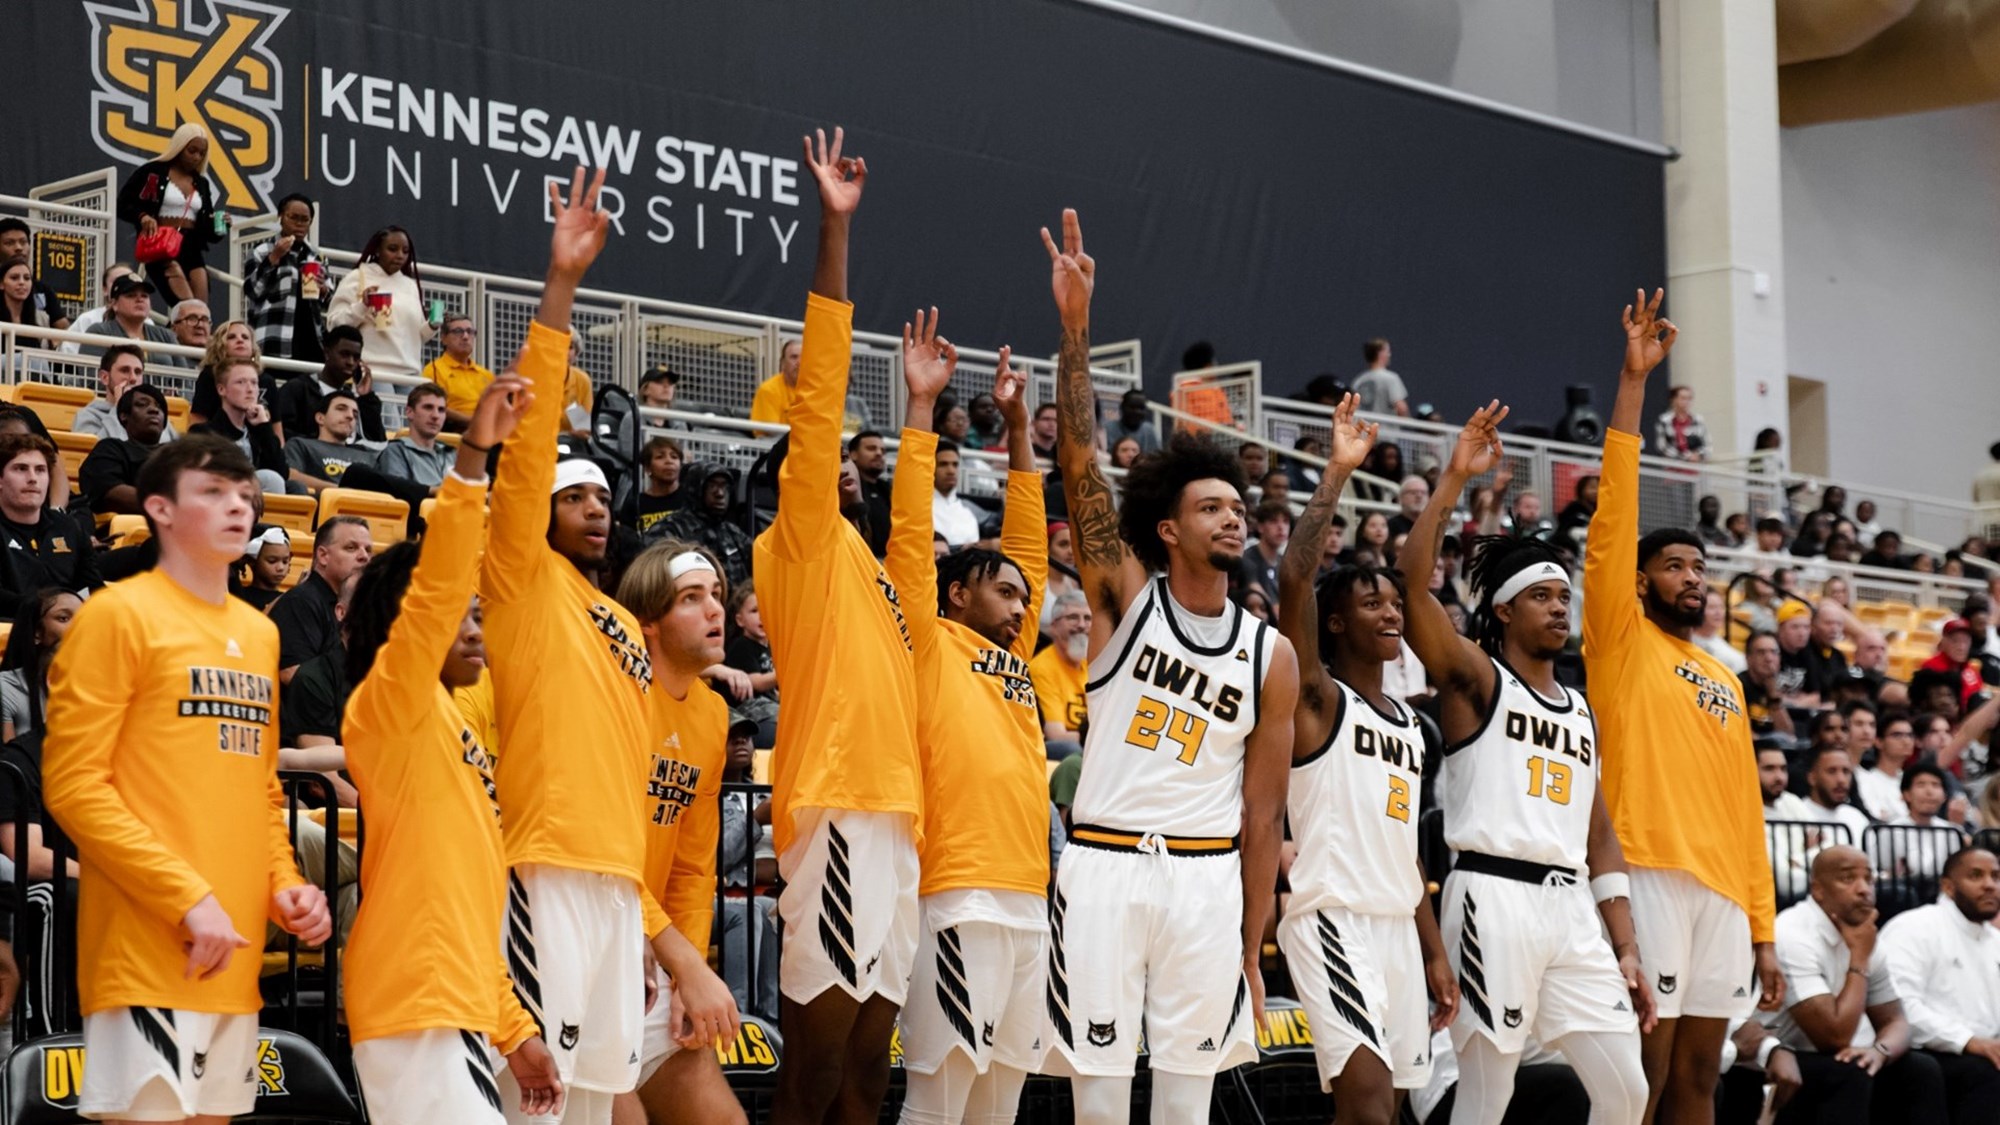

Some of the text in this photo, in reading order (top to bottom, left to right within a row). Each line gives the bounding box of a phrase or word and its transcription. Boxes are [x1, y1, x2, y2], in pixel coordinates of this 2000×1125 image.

[321, 66, 800, 206] KENNESAW STATE
[321, 133, 800, 263] UNIVERSITY
[48, 251, 76, 270] 105
[1132, 643, 1243, 723] OWLS
[181, 701, 270, 723] BASKETBAL
[1125, 694, 1210, 767] 24
[220, 723, 261, 756] STATE
[1354, 724, 1425, 776] OWL
[1506, 710, 1592, 767] OWLS
[1386, 773, 1410, 824] 2
[1527, 755, 1573, 806] 13
[715, 1022, 776, 1065] WLS
[46, 1048, 87, 1100] OW
